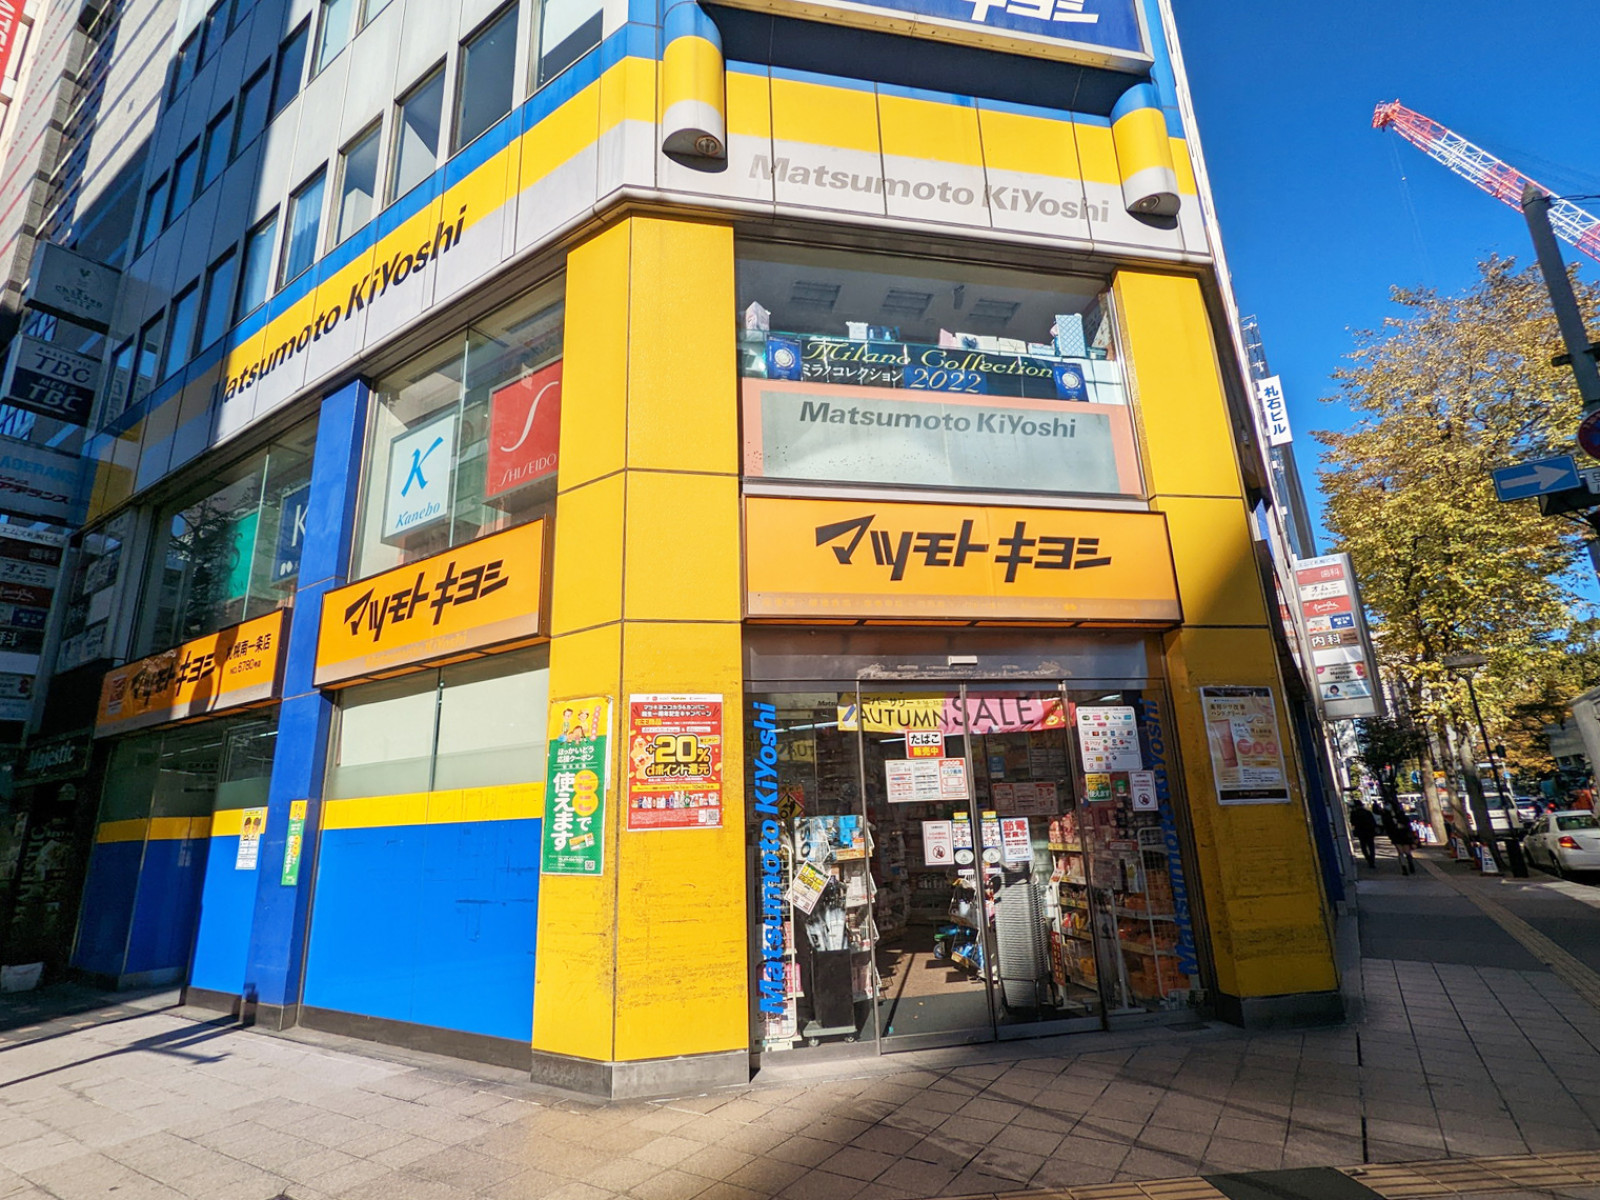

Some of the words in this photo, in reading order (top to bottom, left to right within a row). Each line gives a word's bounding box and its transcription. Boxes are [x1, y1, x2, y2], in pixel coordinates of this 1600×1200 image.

[748, 153, 975, 206] Matsumoto
[984, 183, 1109, 224] KiYoshi
[344, 203, 467, 321] KiYoshi
[34, 353, 91, 384] TBC
[800, 361, 903, 384] ミラノコレクション
[920, 348, 1054, 379] Collection
[910, 367, 982, 394] 2022
[28, 382, 83, 413] TBC
[1264, 384, 1286, 436] 札石ビル
[800, 400, 971, 433] Matsumoto
[976, 411, 1076, 438] KiYoshi
[401, 436, 444, 498] K
[498, 452, 557, 488] SHISEIDO
[395, 501, 441, 530] Kanebo
[815, 514, 1112, 583] マツモトキヨシ
[344, 560, 509, 642] マツモトキヨシ
[1311, 633, 1341, 647] 内科
[856, 705, 949, 728] AUTUMN
[952, 694, 1035, 728] SALE
[557, 745, 594, 756] ほっかいどう
[646, 735, 711, 764] +20%
[910, 733, 940, 745] たばこ
[913, 746, 940, 757] 販売中
[645, 763, 711, 776] dポイント還元
[752, 701, 779, 815] KiYoshi
[550, 771, 576, 852] 使えます
[757, 818, 785, 1015] Matsumoto
